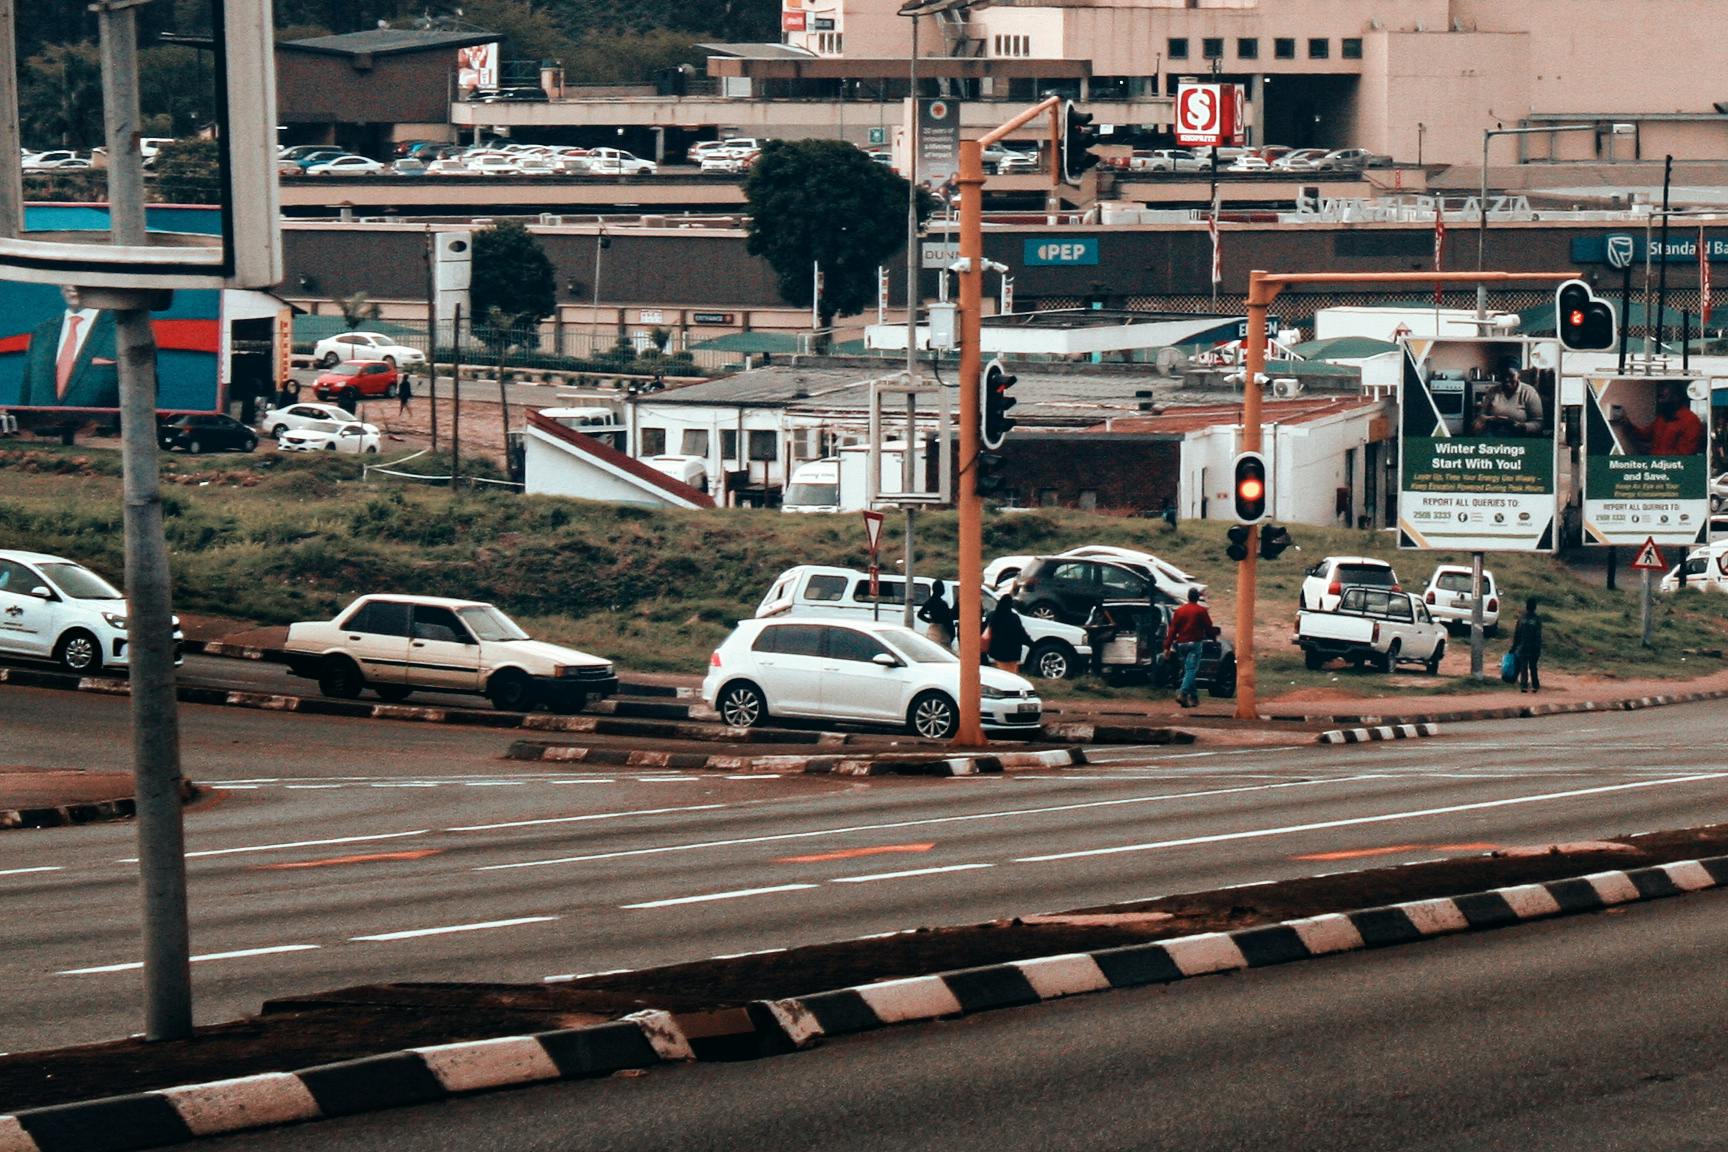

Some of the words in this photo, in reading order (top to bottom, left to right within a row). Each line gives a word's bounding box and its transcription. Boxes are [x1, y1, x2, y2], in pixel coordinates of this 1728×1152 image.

[1416, 195, 1534, 223] PLAZA
[1047, 244, 1086, 261] PEP
[1650, 241, 1711, 256] Standad
[1435, 443, 1475, 454] Winter
[1478, 443, 1525, 457] Savings
[1432, 458, 1462, 469] Start
[1465, 458, 1493, 469] With
[1496, 459, 1522, 470] You!
[1624, 472, 1641, 480] and
[1423, 498, 1453, 506] REPORT
[1456, 498, 1469, 506] ALL
[1472, 498, 1505, 507] QUERIES
